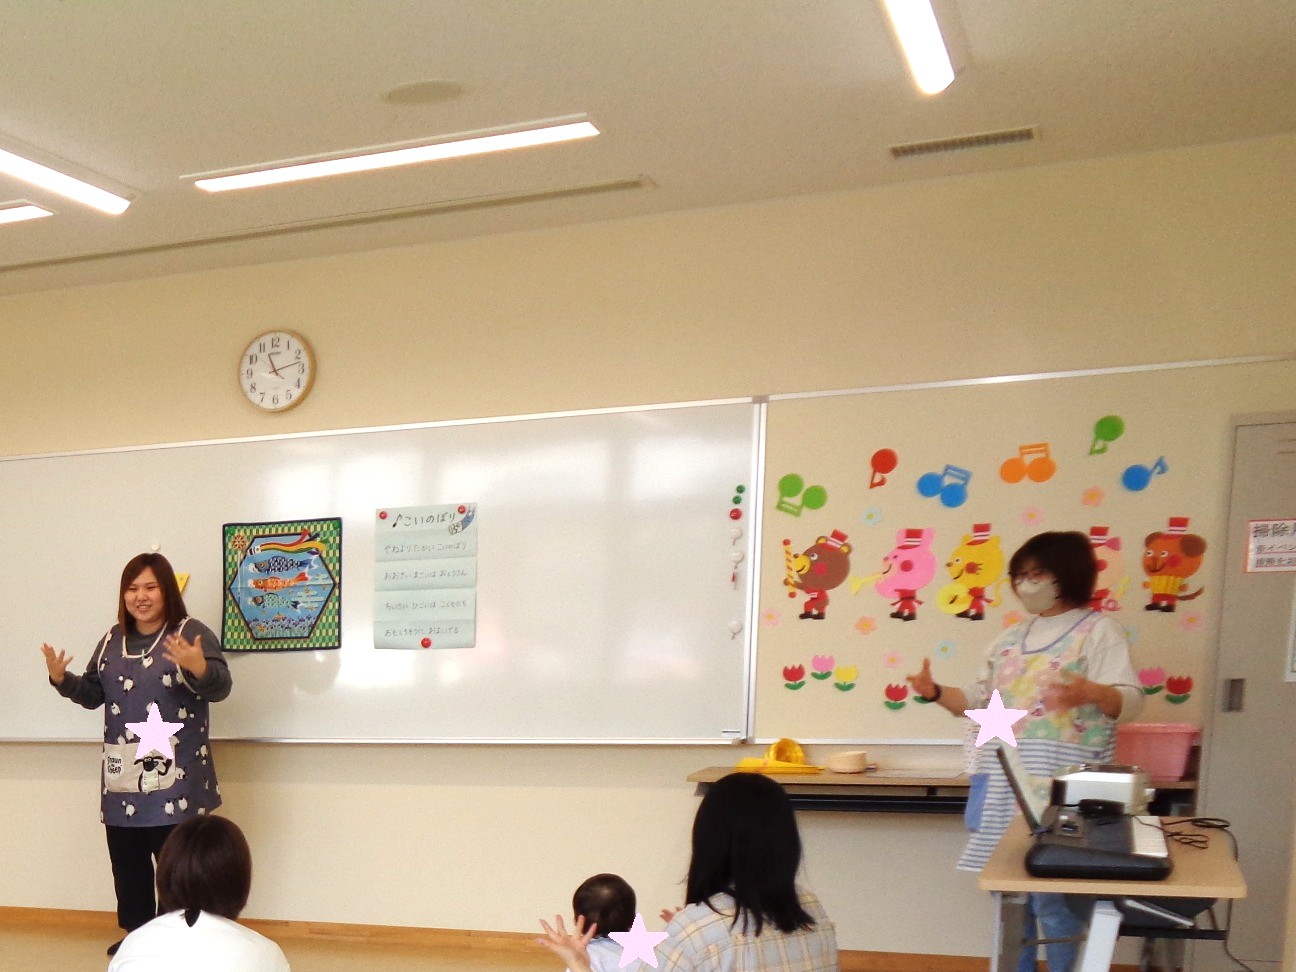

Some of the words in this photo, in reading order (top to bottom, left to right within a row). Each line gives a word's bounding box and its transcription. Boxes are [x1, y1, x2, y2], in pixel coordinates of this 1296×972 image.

[259, 342, 265, 353] 11
[271, 337, 280, 348] 12
[249, 353, 257, 365] 10
[294, 348, 301, 360] 2
[246, 368, 253, 379] 9
[298, 363, 305, 374] 3
[250, 382, 256, 393] 8
[294, 377, 301, 389] 4
[259, 392, 265, 402] 7
[272, 394, 278, 405] 6
[285, 389, 292, 400] 5
[404, 511, 455, 527] こいのぼり
[1253, 523, 1296, 538] 掃除
